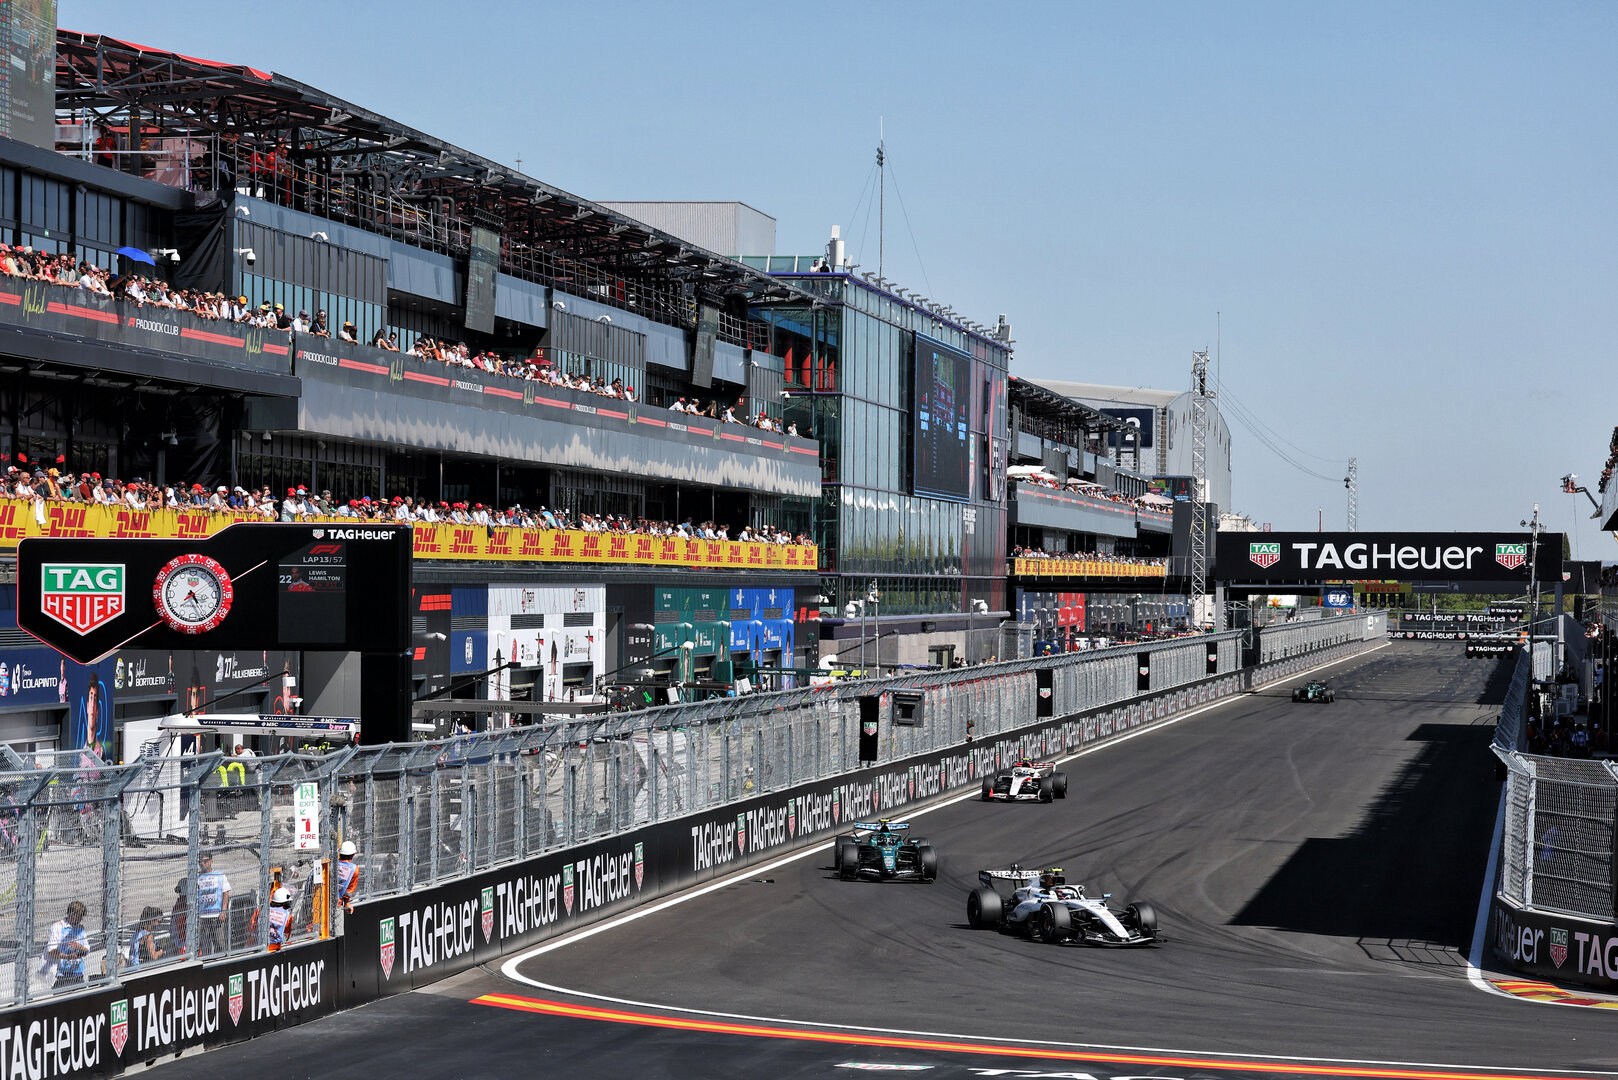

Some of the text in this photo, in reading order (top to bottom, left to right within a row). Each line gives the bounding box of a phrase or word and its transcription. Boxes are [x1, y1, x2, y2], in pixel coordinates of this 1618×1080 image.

[136, 318, 164, 333] PADDOCK
[163, 322, 179, 336] CLUB
[303, 351, 325, 363] PADDOCK
[325, 354, 338, 366] CLUB
[327, 529, 396, 540] TAGHeuer
[413, 527, 437, 552] DHL
[451, 529, 474, 553] DHL
[521, 533, 540, 555] DHL
[1250, 544, 1279, 567] TAG HEUER
[1292, 543, 1483, 570] TAGHeuer
[1499, 545, 1524, 554] TAG
[169, 558, 179, 567] 55
[205, 558, 215, 567] 05
[49, 569, 117, 590] TAG
[157, 571, 165, 581] 50
[220, 572, 227, 580] 10
[280, 575, 292, 583] 22
[226, 591, 231, 599] 15
[45, 596, 120, 632] HEUER
[220, 608, 228, 618] 20
[1414, 614, 1455, 622] TAGHeuer
[1416, 632, 1457, 640] TAGHeuer
[128, 662, 133, 687] 5
[225, 657, 232, 678] 27
[12, 664, 21, 695] 43
[22, 677, 58, 688] COLAPINTO
[136, 676, 165, 687] BORTOLETO
[840, 782, 872, 822] TAGHeuer
[797, 793, 832, 836] TAGHeuer
[747, 804, 786, 852] TAGHeuer
[692, 820, 736, 871] TAGHeuer
[577, 851, 633, 912] TAGHeuer
[482, 889, 493, 910] TAG
[497, 873, 560, 939] TAGHeuer
[381, 920, 394, 943] TAG
[399, 898, 478, 974] TAGHeuer
[1551, 932, 1567, 966] TAG HEUER
[230, 977, 242, 995] TAG
[248, 960, 324, 1023] TAGHeuer
[112, 1005, 126, 1023] TAG
[134, 984, 224, 1051] TAGHeuer
